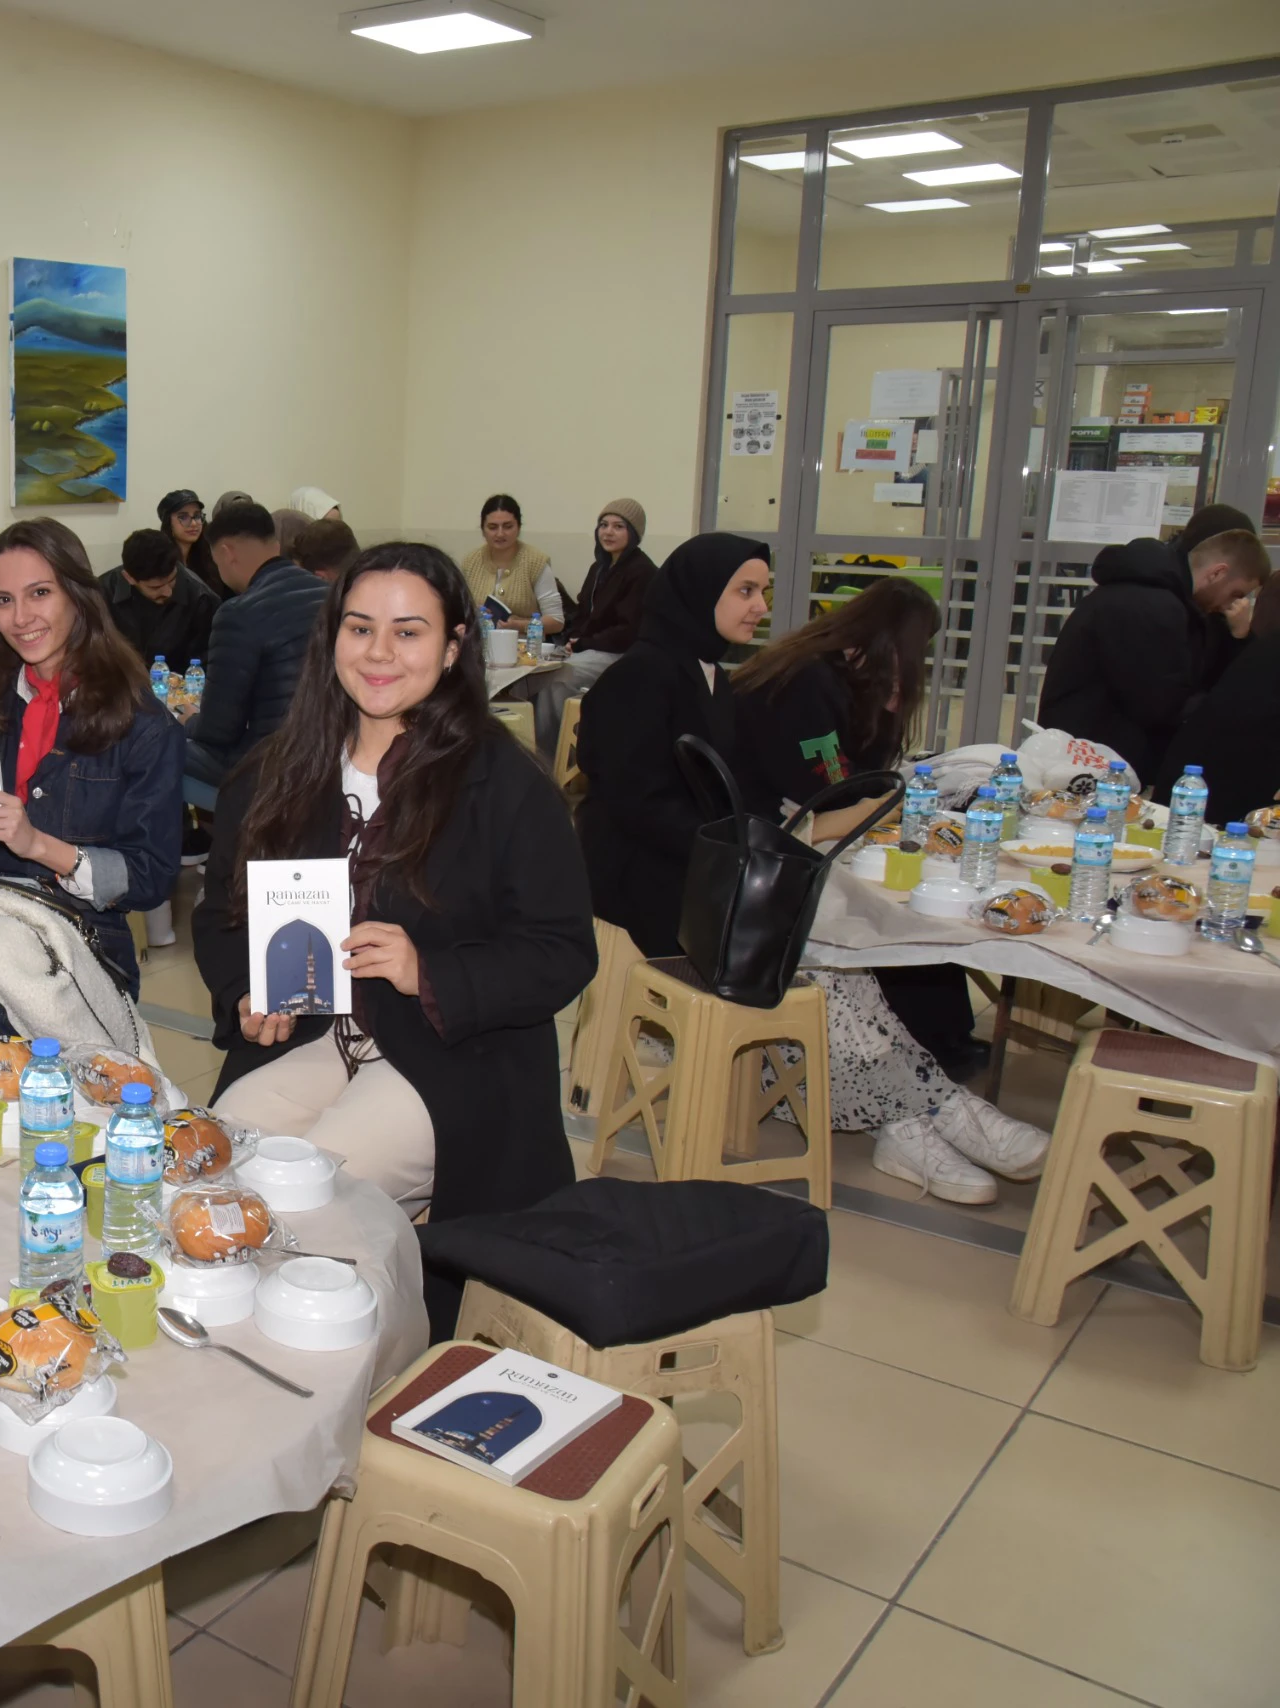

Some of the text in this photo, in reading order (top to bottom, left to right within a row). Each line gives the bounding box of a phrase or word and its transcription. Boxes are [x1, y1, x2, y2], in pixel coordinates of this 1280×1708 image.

[1071, 429, 1101, 437] roma
[266, 890, 330, 906] Ramazan
[498, 1368, 580, 1402] Ramazan
